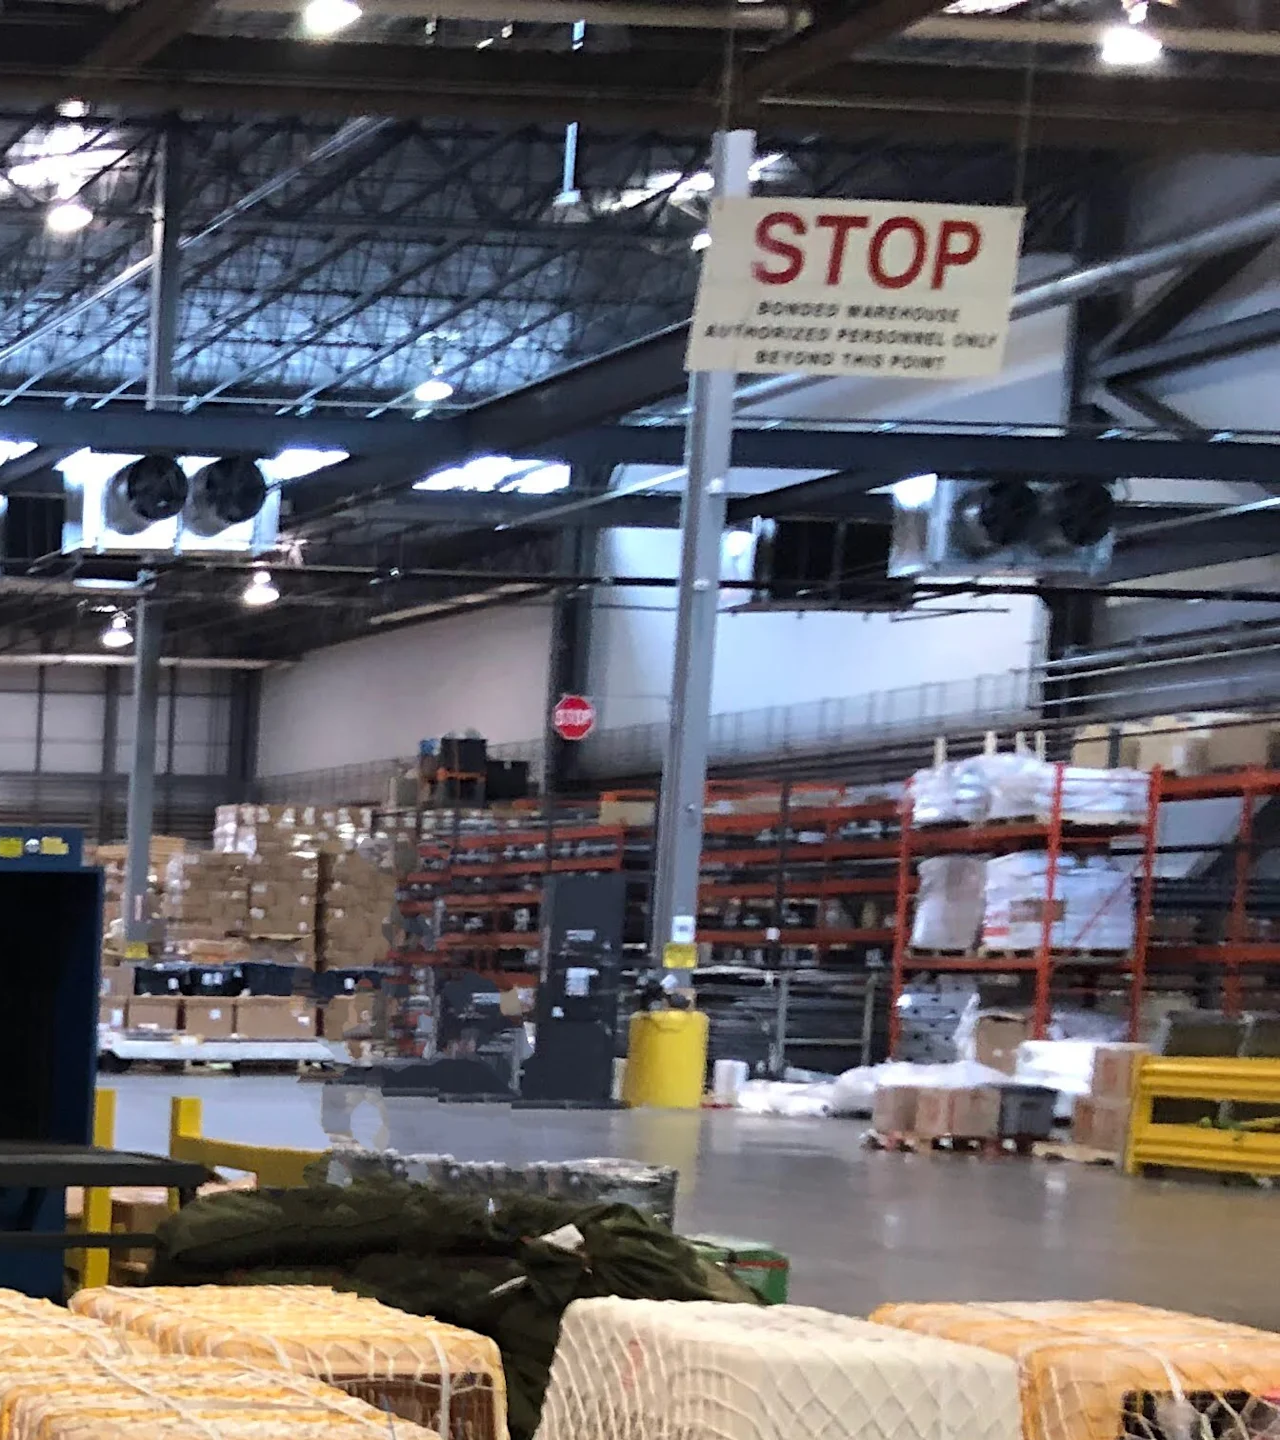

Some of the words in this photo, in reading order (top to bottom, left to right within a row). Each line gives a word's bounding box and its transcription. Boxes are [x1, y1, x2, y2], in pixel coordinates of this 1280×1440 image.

[751, 211, 982, 290] STOP
[756, 300, 839, 319] BONDED
[847, 304, 961, 323] WAREHOUSE
[704, 322, 832, 341] AUTHORIZED
[837, 327, 946, 347] PERSONNEL
[952, 332, 999, 349] ONLY
[755, 349, 836, 366] BEYOND
[842, 352, 885, 369] THIS
[891, 353, 946, 370] POINT
